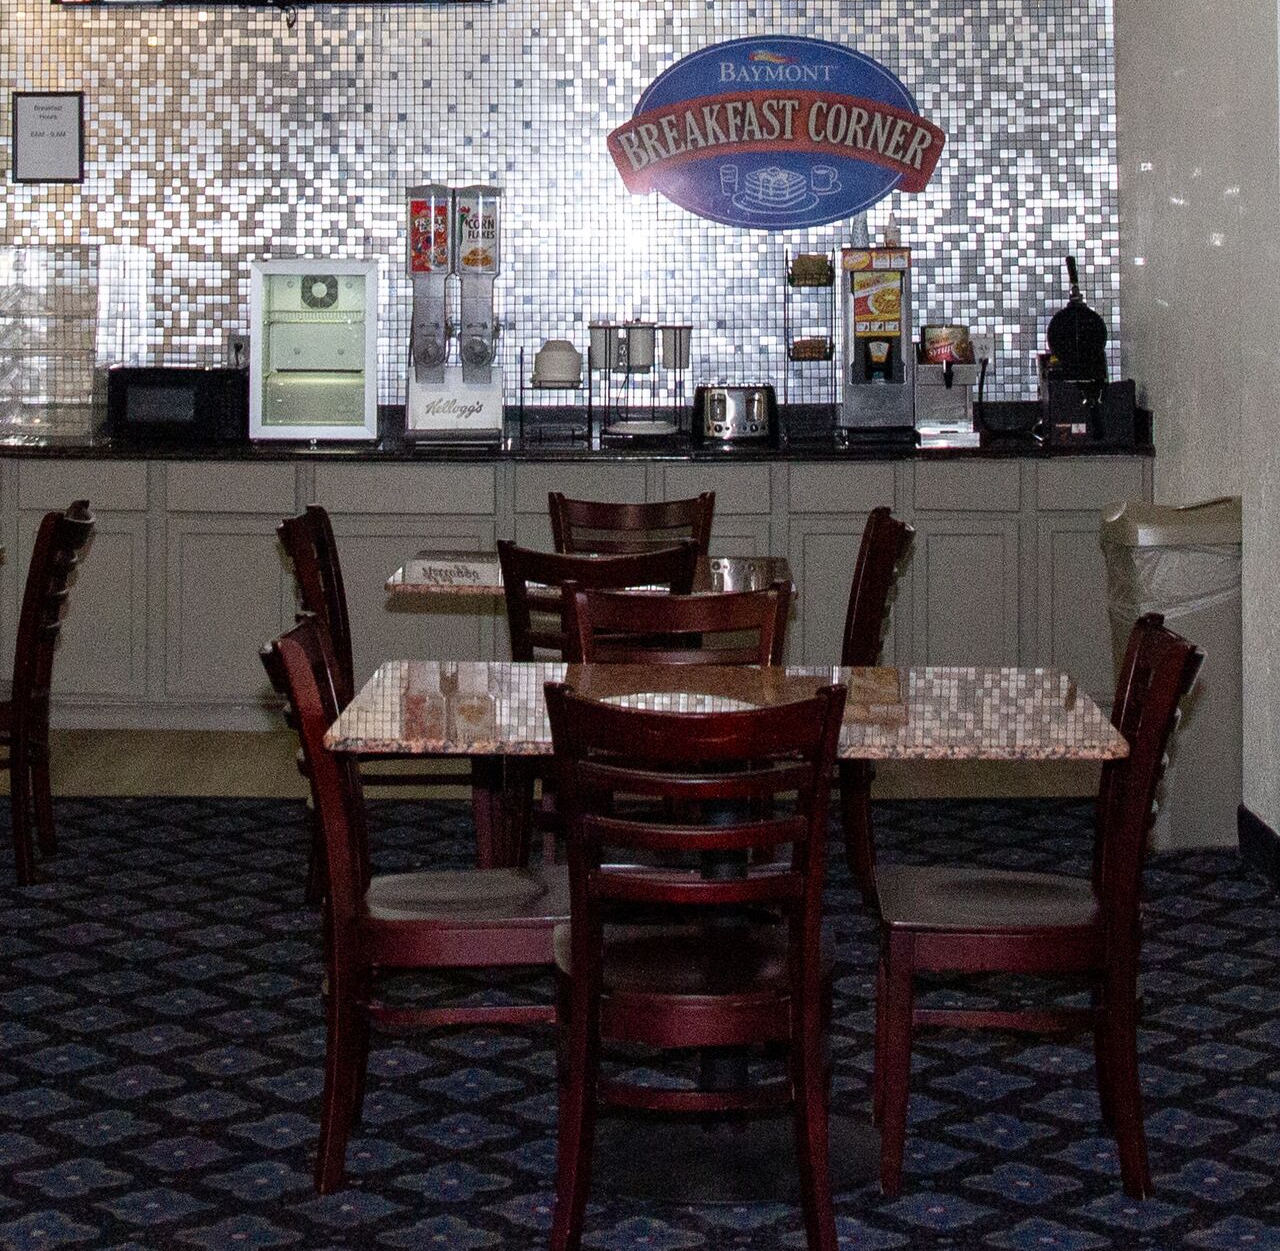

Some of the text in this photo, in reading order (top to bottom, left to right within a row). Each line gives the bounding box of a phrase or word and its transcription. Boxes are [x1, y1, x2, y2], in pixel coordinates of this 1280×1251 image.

[719, 61, 834, 83] BAYMONT
[617, 97, 933, 173] BREAKFAST CORNER
[467, 230, 496, 240] FLAKES
[468, 218, 495, 230] CORN
[425, 397, 483, 419] Kellogg's
